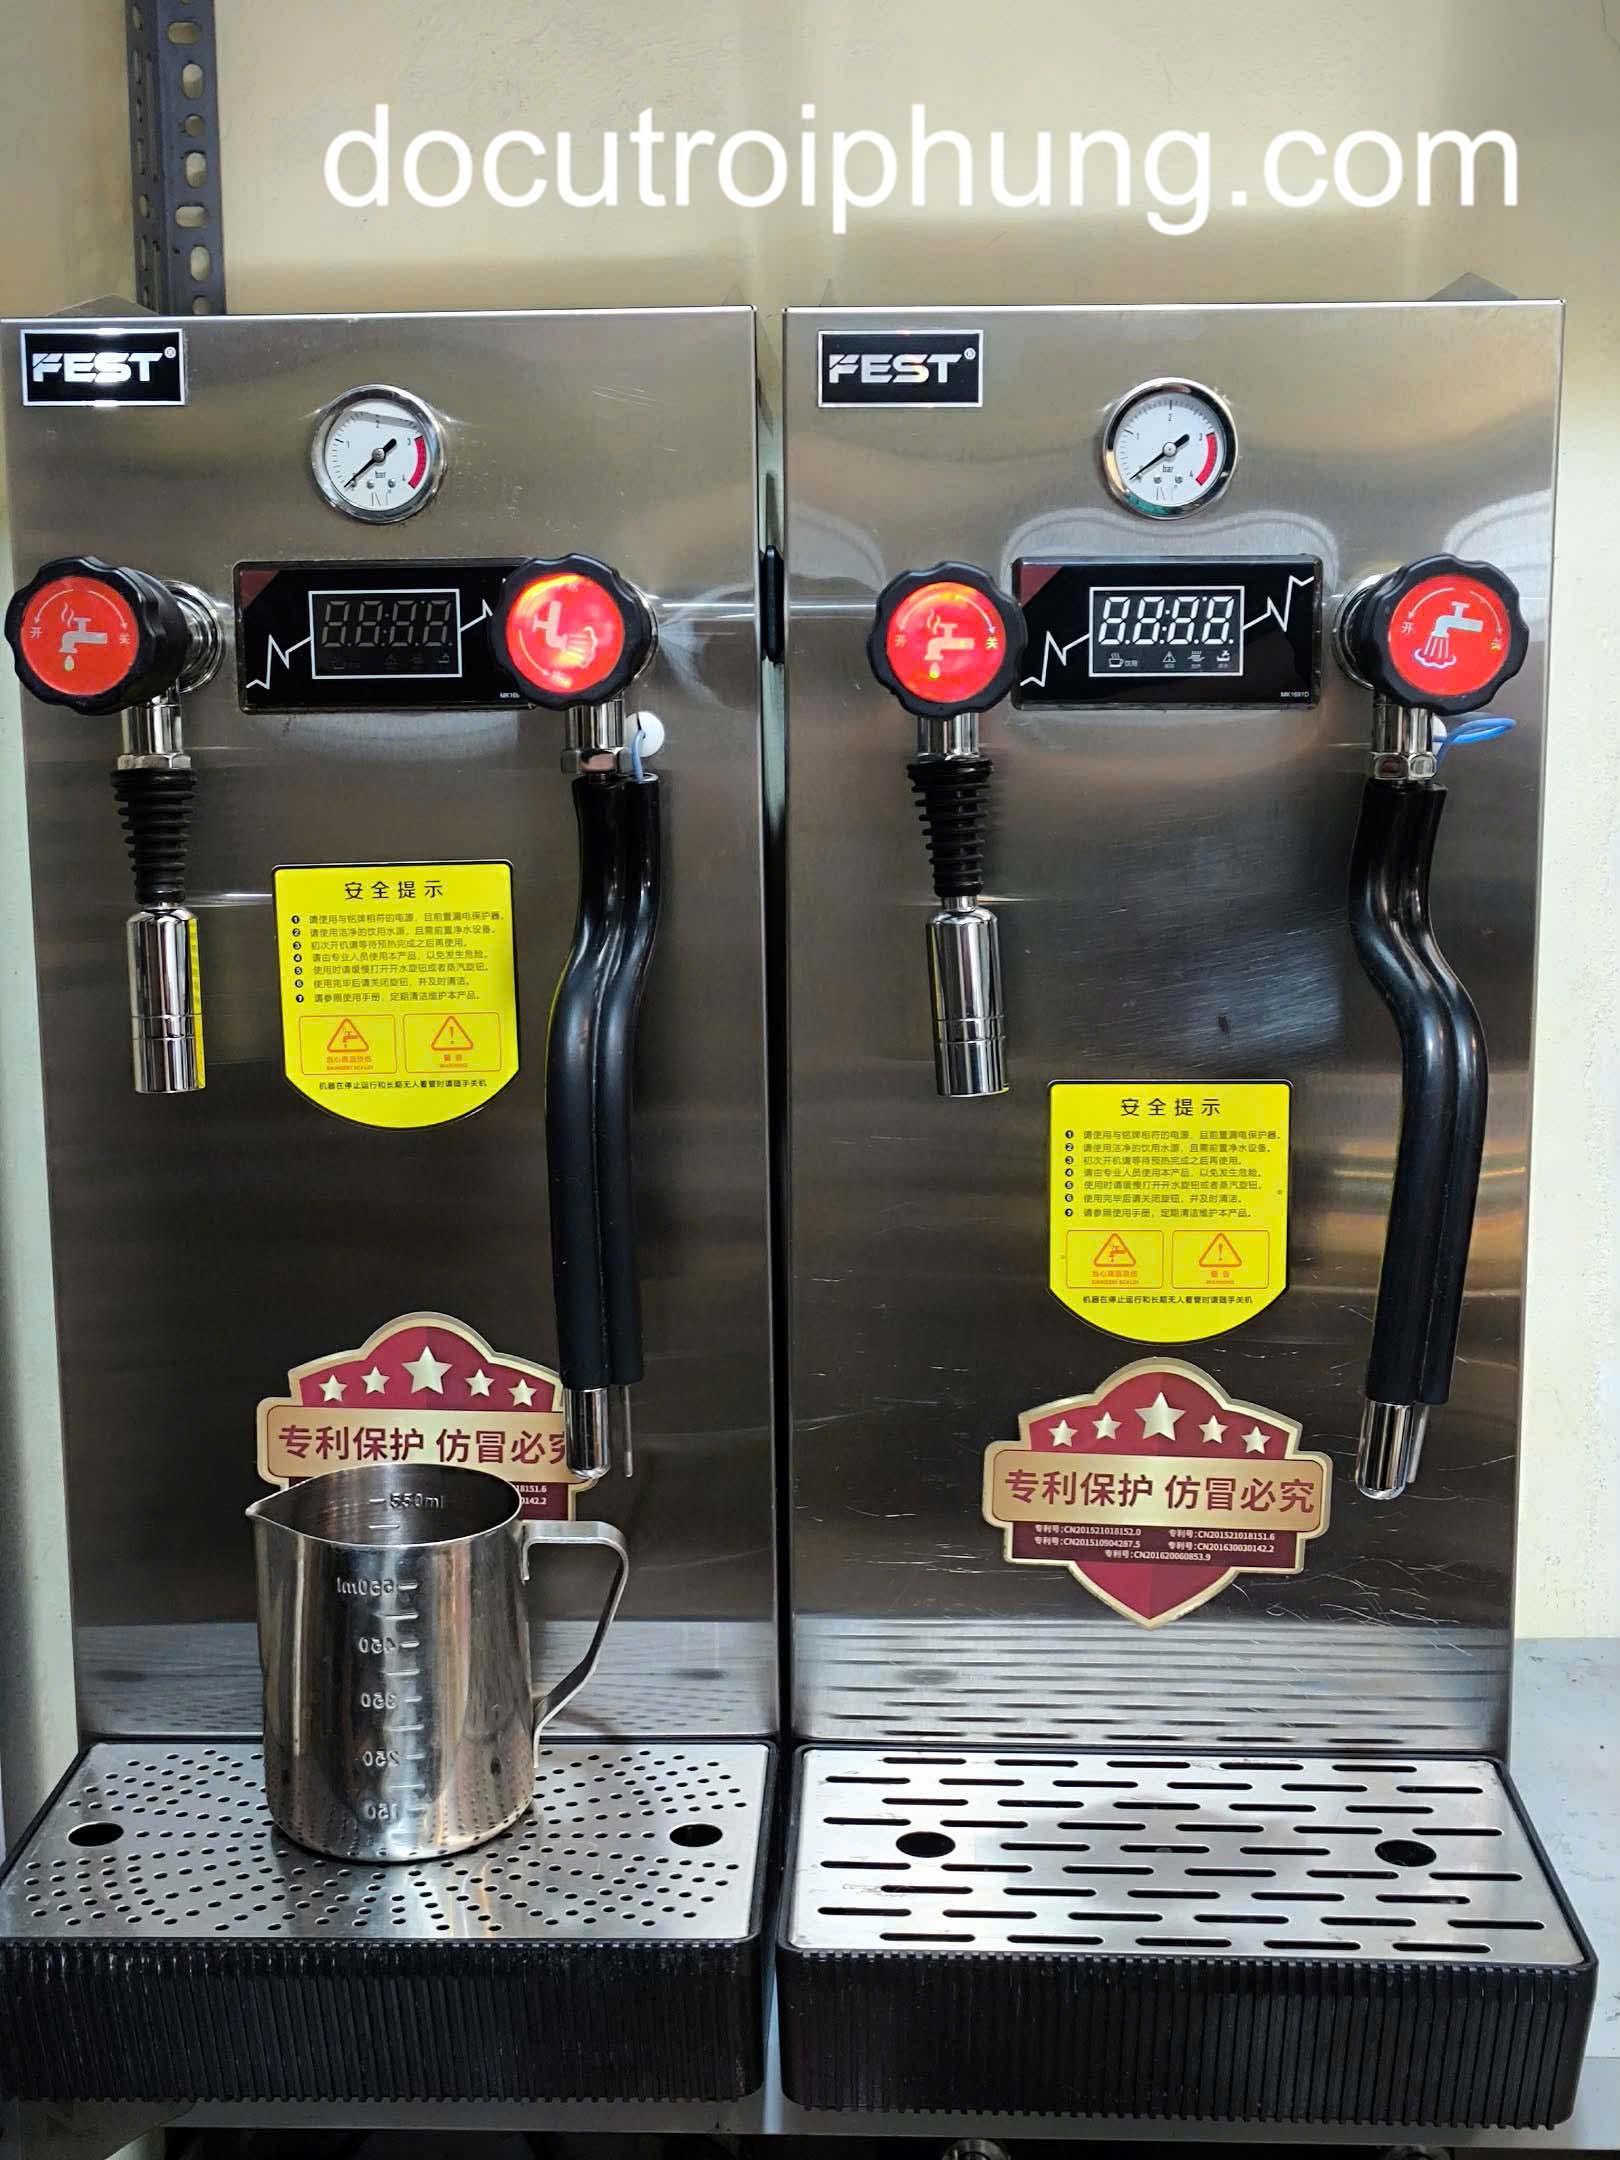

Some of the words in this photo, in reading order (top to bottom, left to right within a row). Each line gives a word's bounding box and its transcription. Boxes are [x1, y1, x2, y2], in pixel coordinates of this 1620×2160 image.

[30, 627, 42, 639] 开
[985, 636, 998, 650] 关
[345, 880, 443, 900] 安全提示
[291, 915, 300, 924] 1
[292, 928, 300, 937] 2
[293, 954, 302, 963] 4
[294, 966, 303, 975] 5
[1121, 1098, 1221, 1117] 安全提示
[1065, 1130, 1074, 1139] 1
[1065, 1142, 1074, 1152] 2
[1065, 1168, 1074, 1177] 4
[1065, 1180, 1074, 1190] 5
[278, 1424, 423, 1462] 专利保护
[1005, 1469, 1153, 1508] 专利保护
[1165, 1474, 1315, 1513] 仿冒必究
[390, 1492, 444, 1510] 550ml
